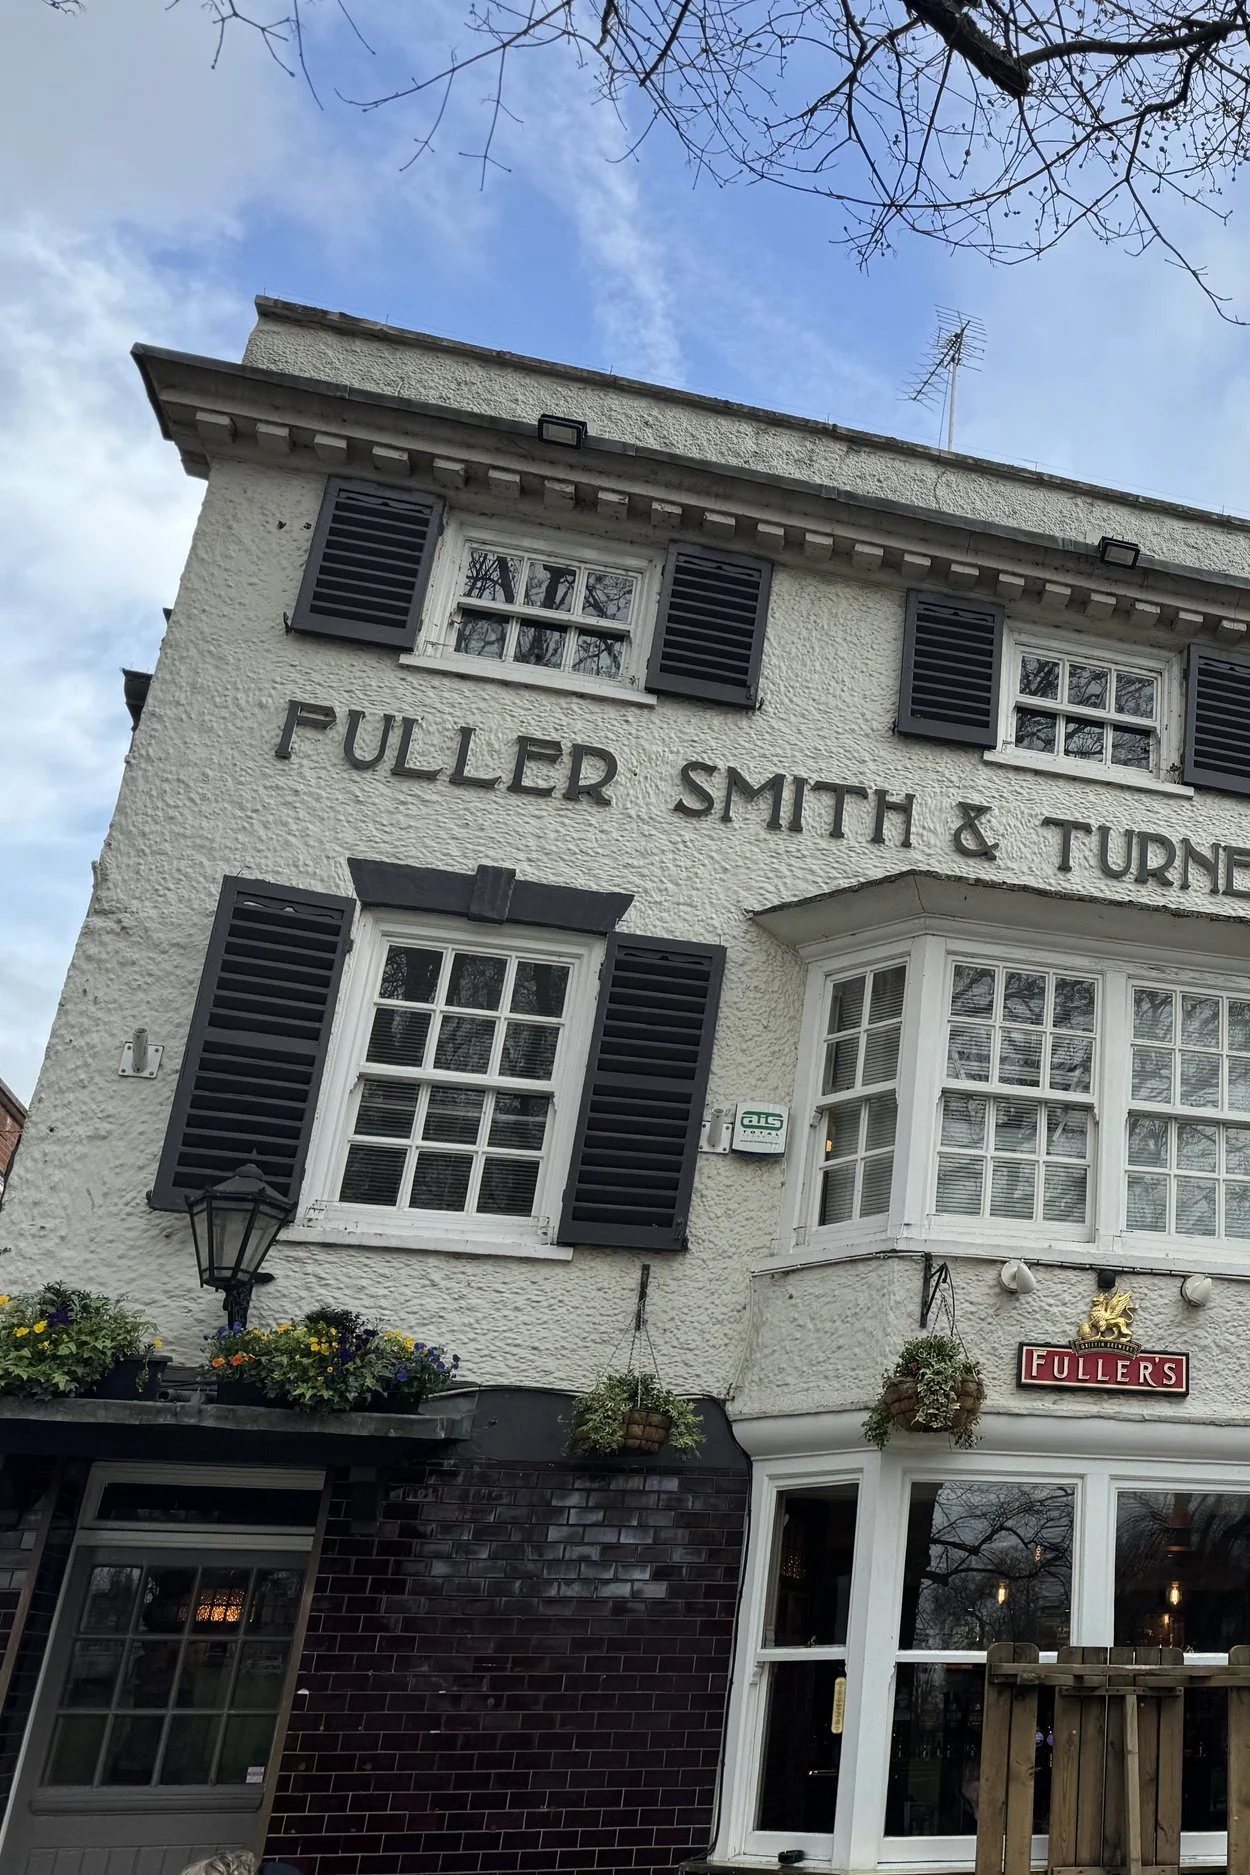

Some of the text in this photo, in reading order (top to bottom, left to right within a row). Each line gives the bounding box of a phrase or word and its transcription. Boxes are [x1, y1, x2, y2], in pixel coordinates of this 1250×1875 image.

[273, 700, 620, 804] FULLER
[673, 760, 915, 848] SMITH
[953, 801, 999, 860] &
[1031, 1350, 1178, 1387] FULLER'S
